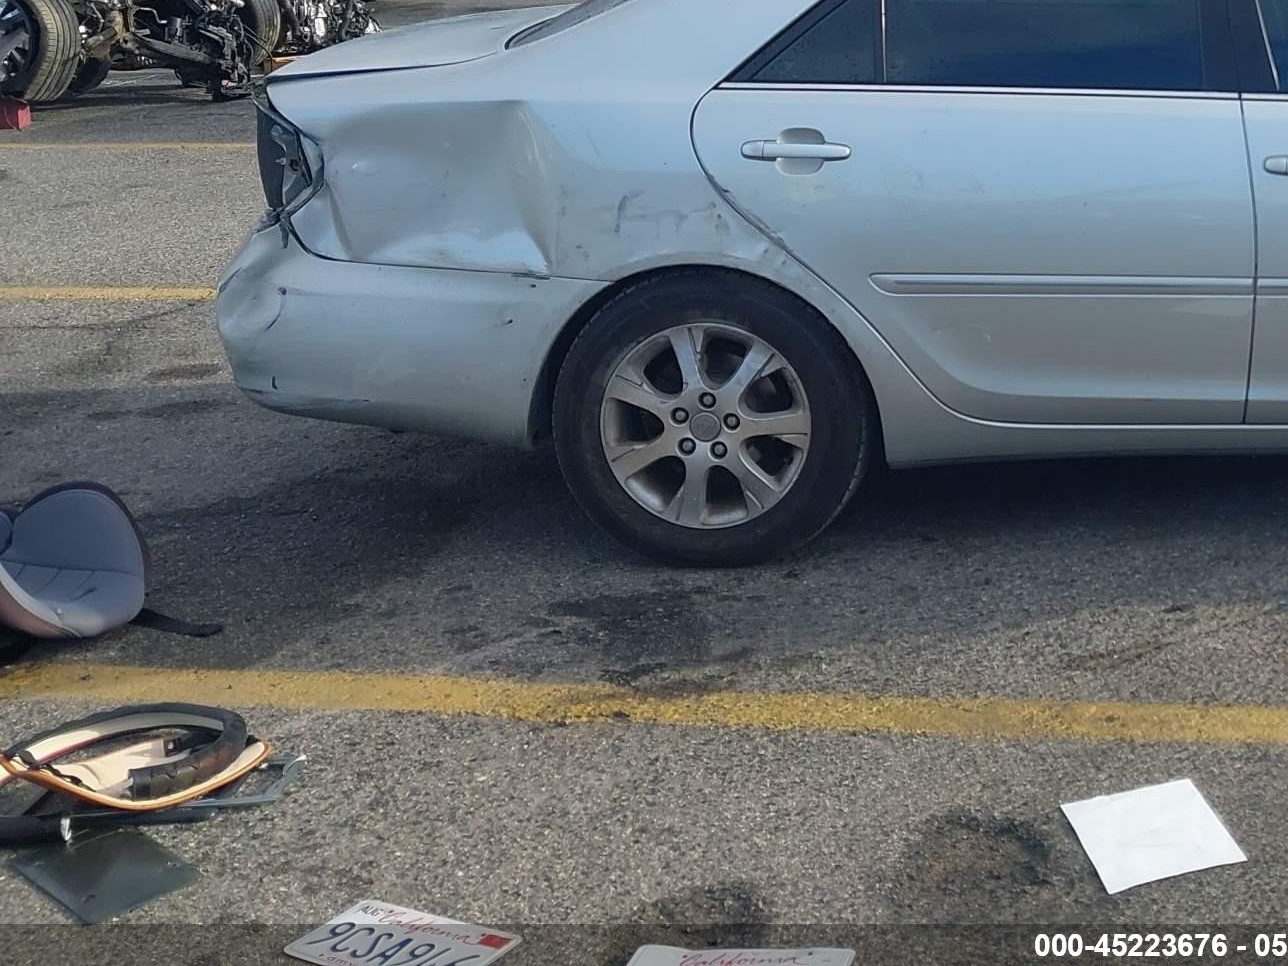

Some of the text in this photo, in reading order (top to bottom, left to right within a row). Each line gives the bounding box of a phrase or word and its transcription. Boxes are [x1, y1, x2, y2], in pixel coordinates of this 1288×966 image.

[357, 905, 384, 917] AUG
[378, 910, 479, 945] California
[680, 952, 808, 966] California
